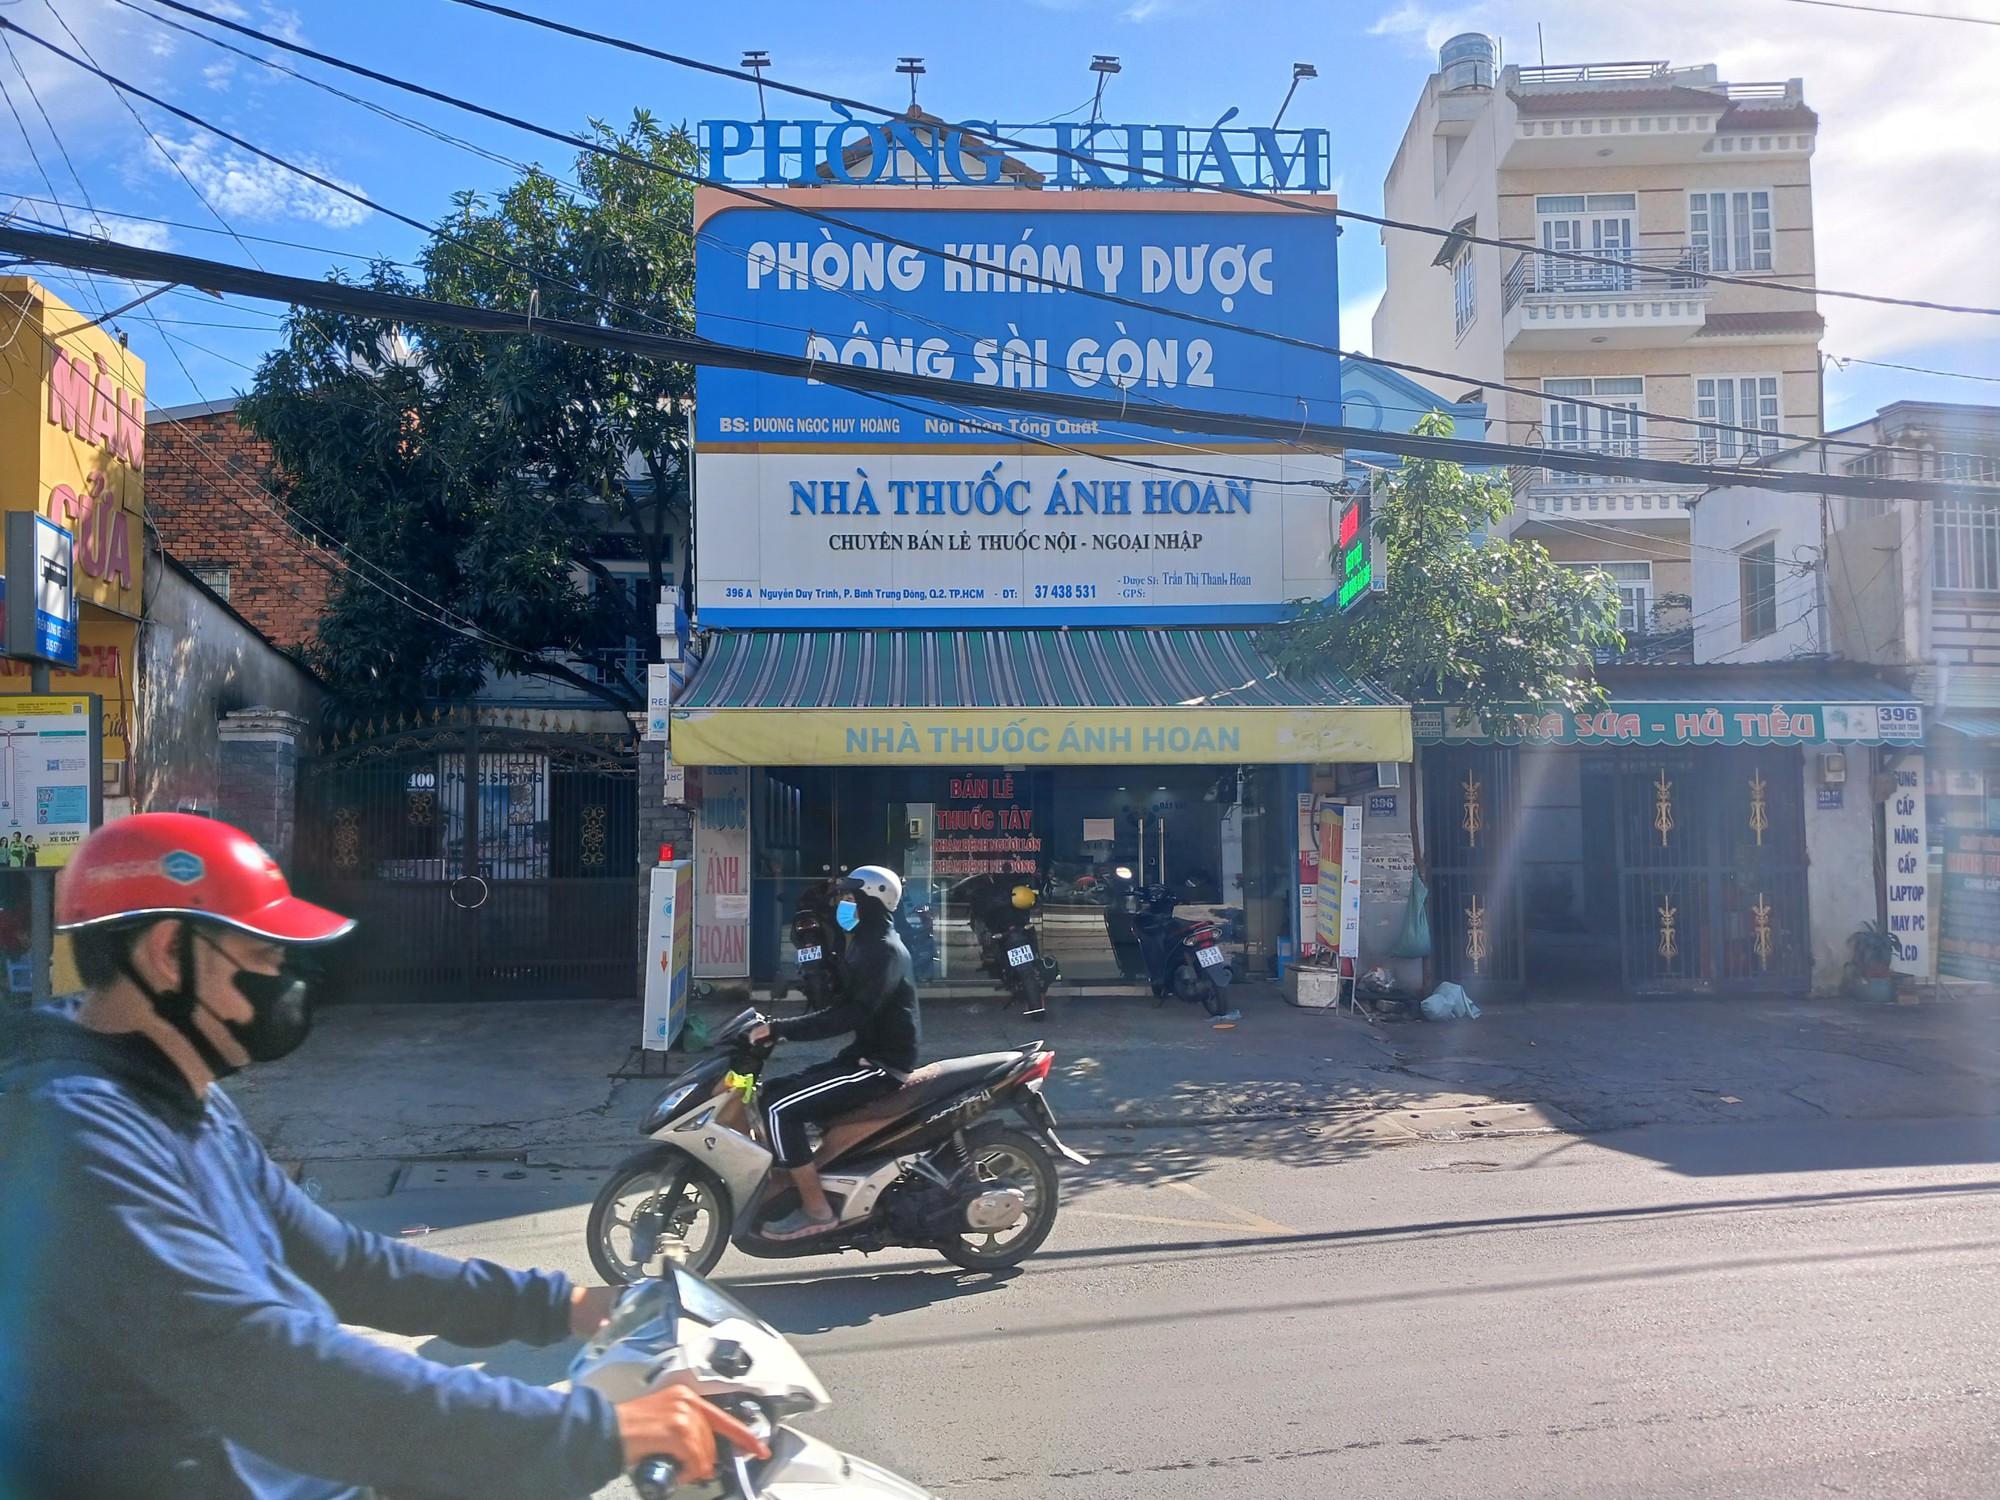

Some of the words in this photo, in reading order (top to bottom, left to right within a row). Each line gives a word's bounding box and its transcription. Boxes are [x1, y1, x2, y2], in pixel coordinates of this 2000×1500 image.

[702, 102, 1006, 184] PHÒNG
[1050, 107, 1327, 189] KHÁM
[747, 227, 926, 291] PHÒNG
[944, 229, 1084, 293] KHÁM
[1097, 245, 1124, 293] Y
[1142, 243, 1273, 312] DƯỢC
[973, 322, 1048, 389] SÀI
[48, 346, 145, 473] MÀN
[720, 417, 749, 433] BS:
[797, 417, 829, 436] NGỌC
[832, 418, 855, 433] HUY
[860, 416, 900, 433] HOÀNG
[925, 417, 954, 435] Nội
[1009, 416, 1051, 438] Tổng
[1056, 417, 1099, 435] Quát
[789, 467, 880, 515] NHÀ
[888, 461, 1031, 516] THUỐC
[1044, 468, 1131, 515] ÁNH
[1142, 479, 1253, 515] HOAN
[48, 469, 133, 592] CỬA
[829, 531, 903, 551] CHUYÊN
[907, 529, 943, 551] BÁN
[948, 530, 972, 551] LẺ
[977, 528, 1040, 551] THUỐC
[1045, 531, 1077, 553] NỘI
[1092, 533, 1150, 552] NGOẠI
[1153, 530, 1203, 551] NHẬP
[1230, 573, 1252, 586] Hoan
[725, 588, 744, 598] 396
[746, 588, 753, 598] A
[796, 590, 813, 601] Duy
[844, 589, 852, 599] P.
[949, 589, 985, 599] TP.HCM
[1003, 589, 1018, 599] ĐT:
[1051, 585, 1072, 599] 438
[1075, 585, 1096, 598] 531
[1123, 589, 1146, 598] GPS:
[1675, 708, 1724, 739] HỦ
[1734, 704, 1816, 738] TIẾU
[1879, 708, 1918, 721] 396
[845, 721, 921, 753] NHÀ
[928, 718, 1049, 753] THUỐC
[1057, 721, 1132, 753] ÁNH
[1142, 726, 1240, 752] HOAN
[407, 773, 435, 788] 400
[447, 772, 486, 784] PAC
[950, 772, 988, 798] BÁN
[992, 772, 1014, 798] LẺ
[1896, 794, 1915, 816] CẤP
[936, 804, 995, 829] THUỐC
[998, 804, 1032, 829] TÂY
[50, 835, 59, 843] XE
[933, 834, 961, 852] KHÁM
[1894, 824, 1919, 844] NÂNG
[1898, 852, 1917, 874] CẤP
[1889, 885, 1925, 903] LAPTOP
[1912, 914, 1925, 932] PC
[698, 924, 746, 964] HOAN
